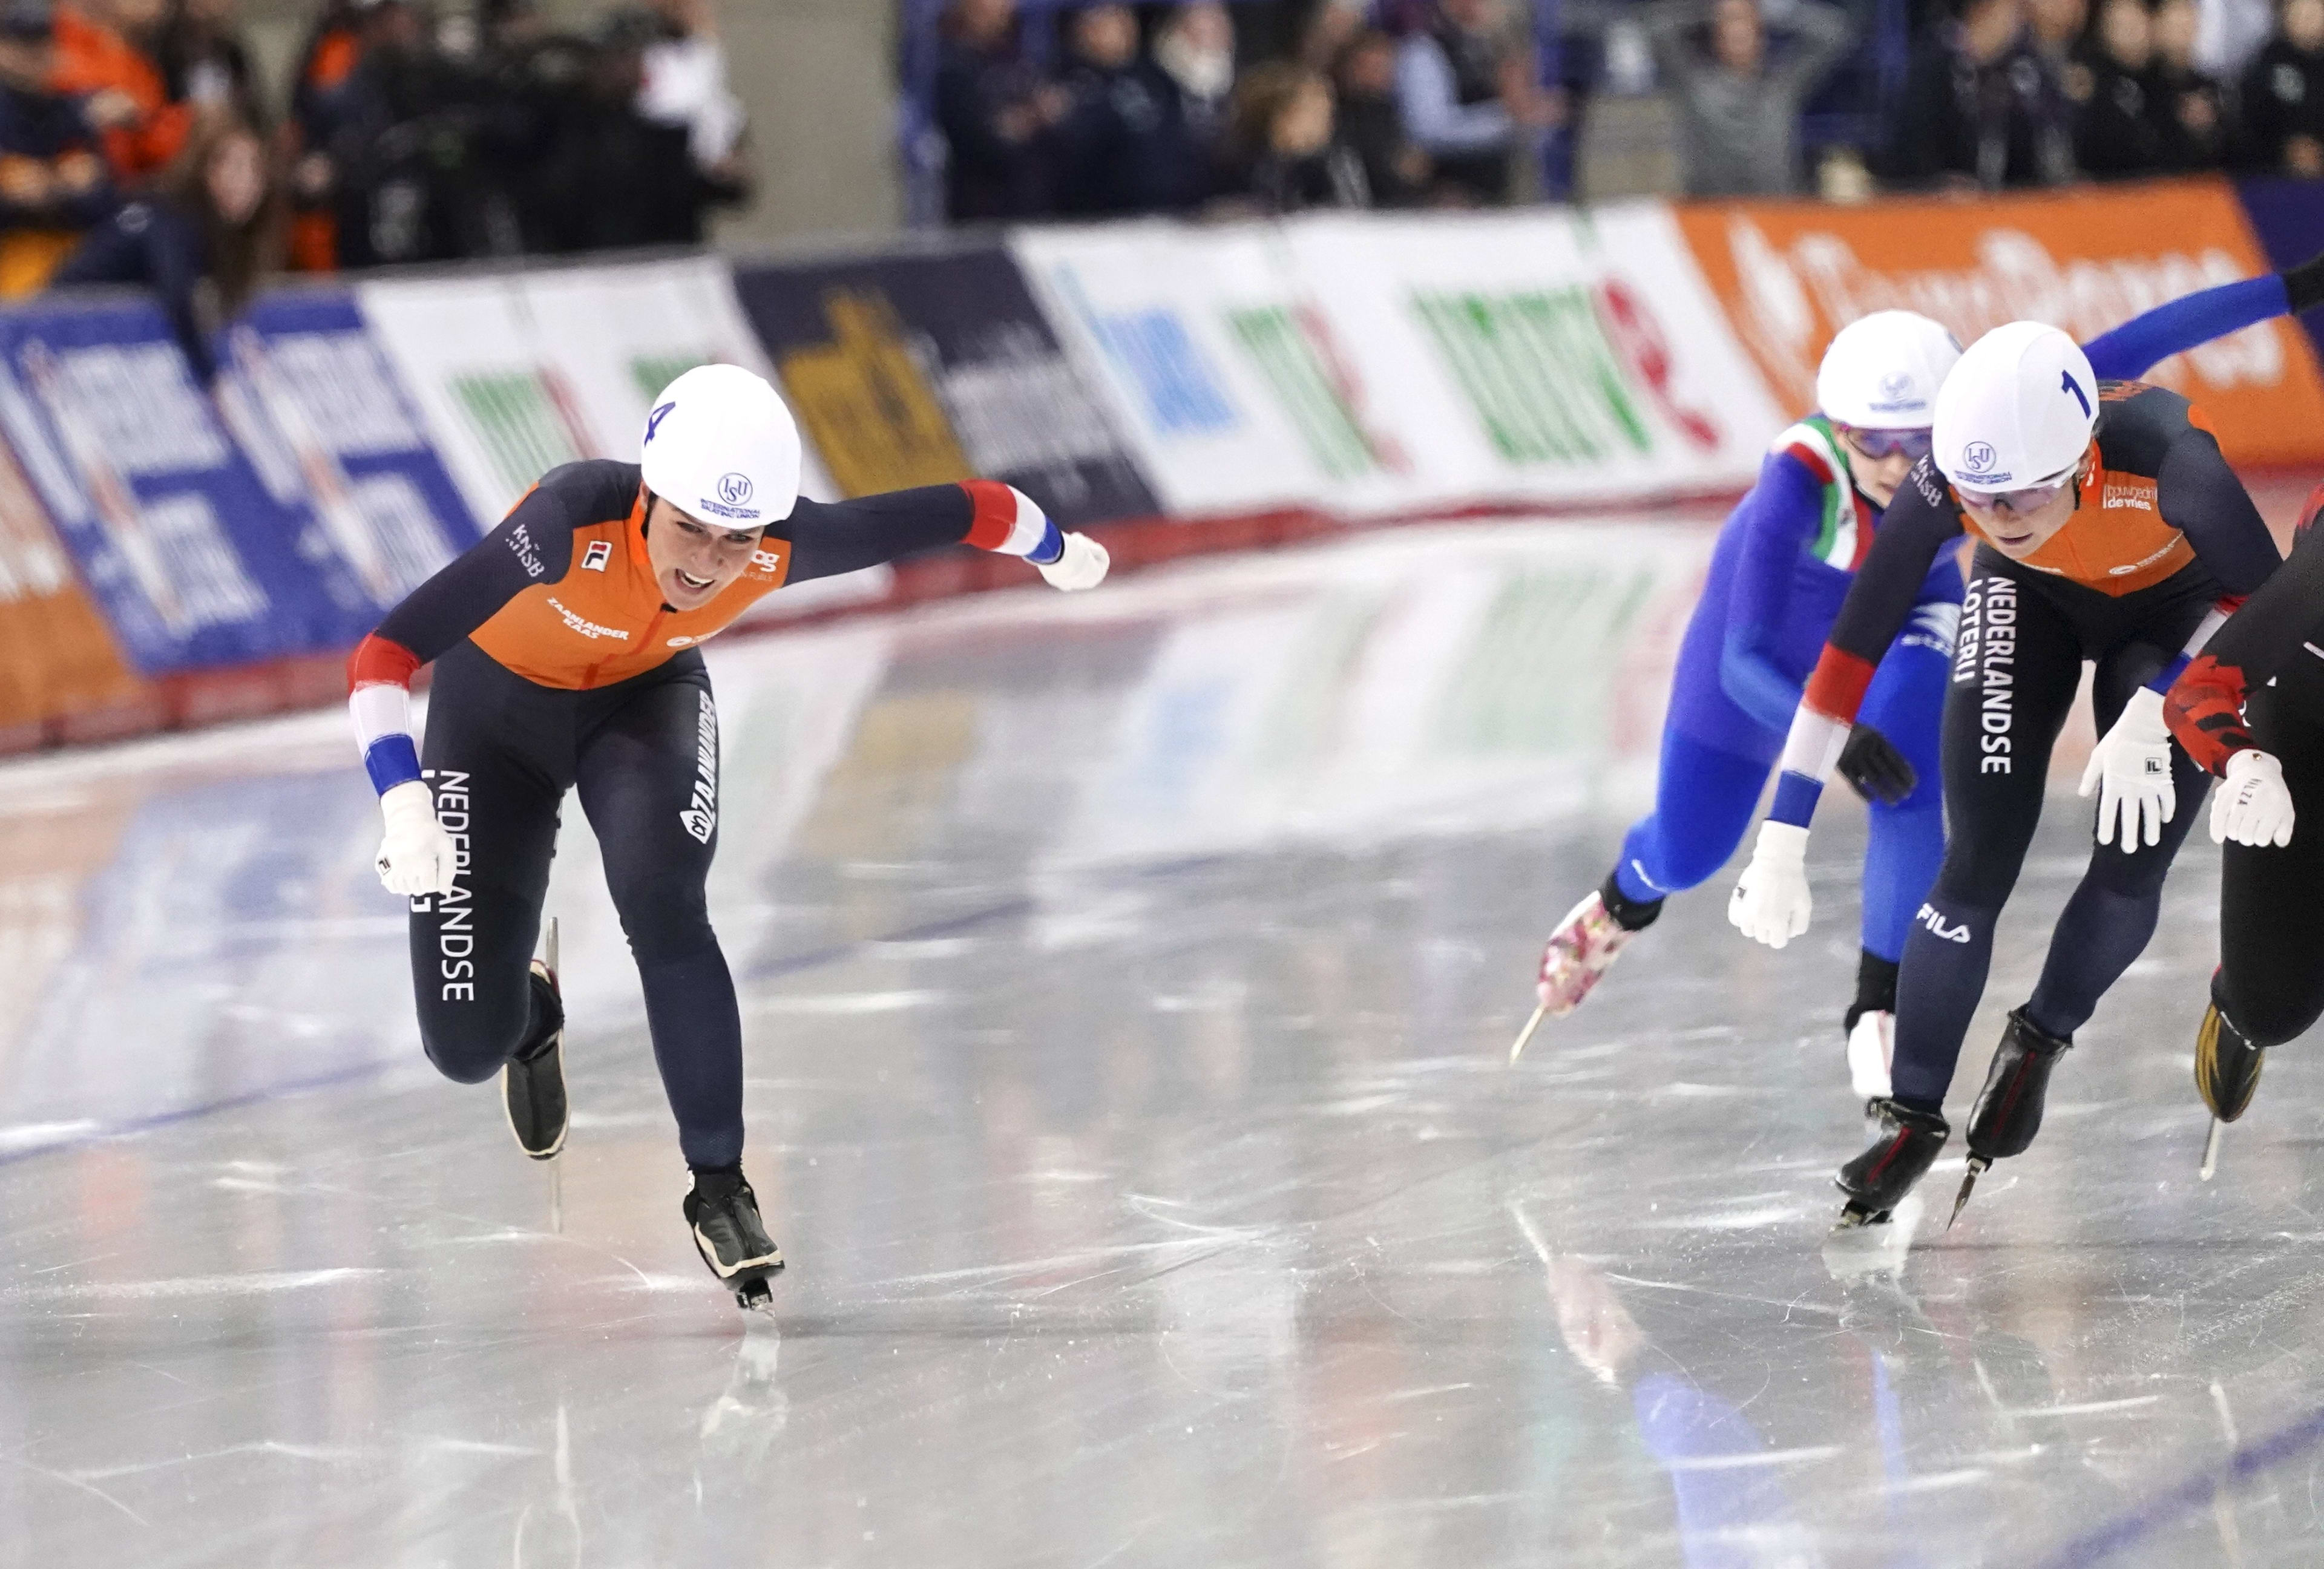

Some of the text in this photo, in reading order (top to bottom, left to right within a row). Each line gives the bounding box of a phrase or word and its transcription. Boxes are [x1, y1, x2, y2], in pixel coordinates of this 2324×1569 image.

[2061, 370, 2090, 419] 1
[644, 401, 675, 448] 4
[1968, 448, 1991, 470] ISU
[724, 479, 748, 502] ISU
[2107, 496, 2152, 511] de vries
[548, 597, 629, 640] ZAANLANDER
[563, 618, 600, 639] KAAS
[1953, 578, 1983, 683] LOTERIJ
[1981, 577, 2017, 775] NEDERLANDSE
[1916, 902, 1971, 943] FILA
